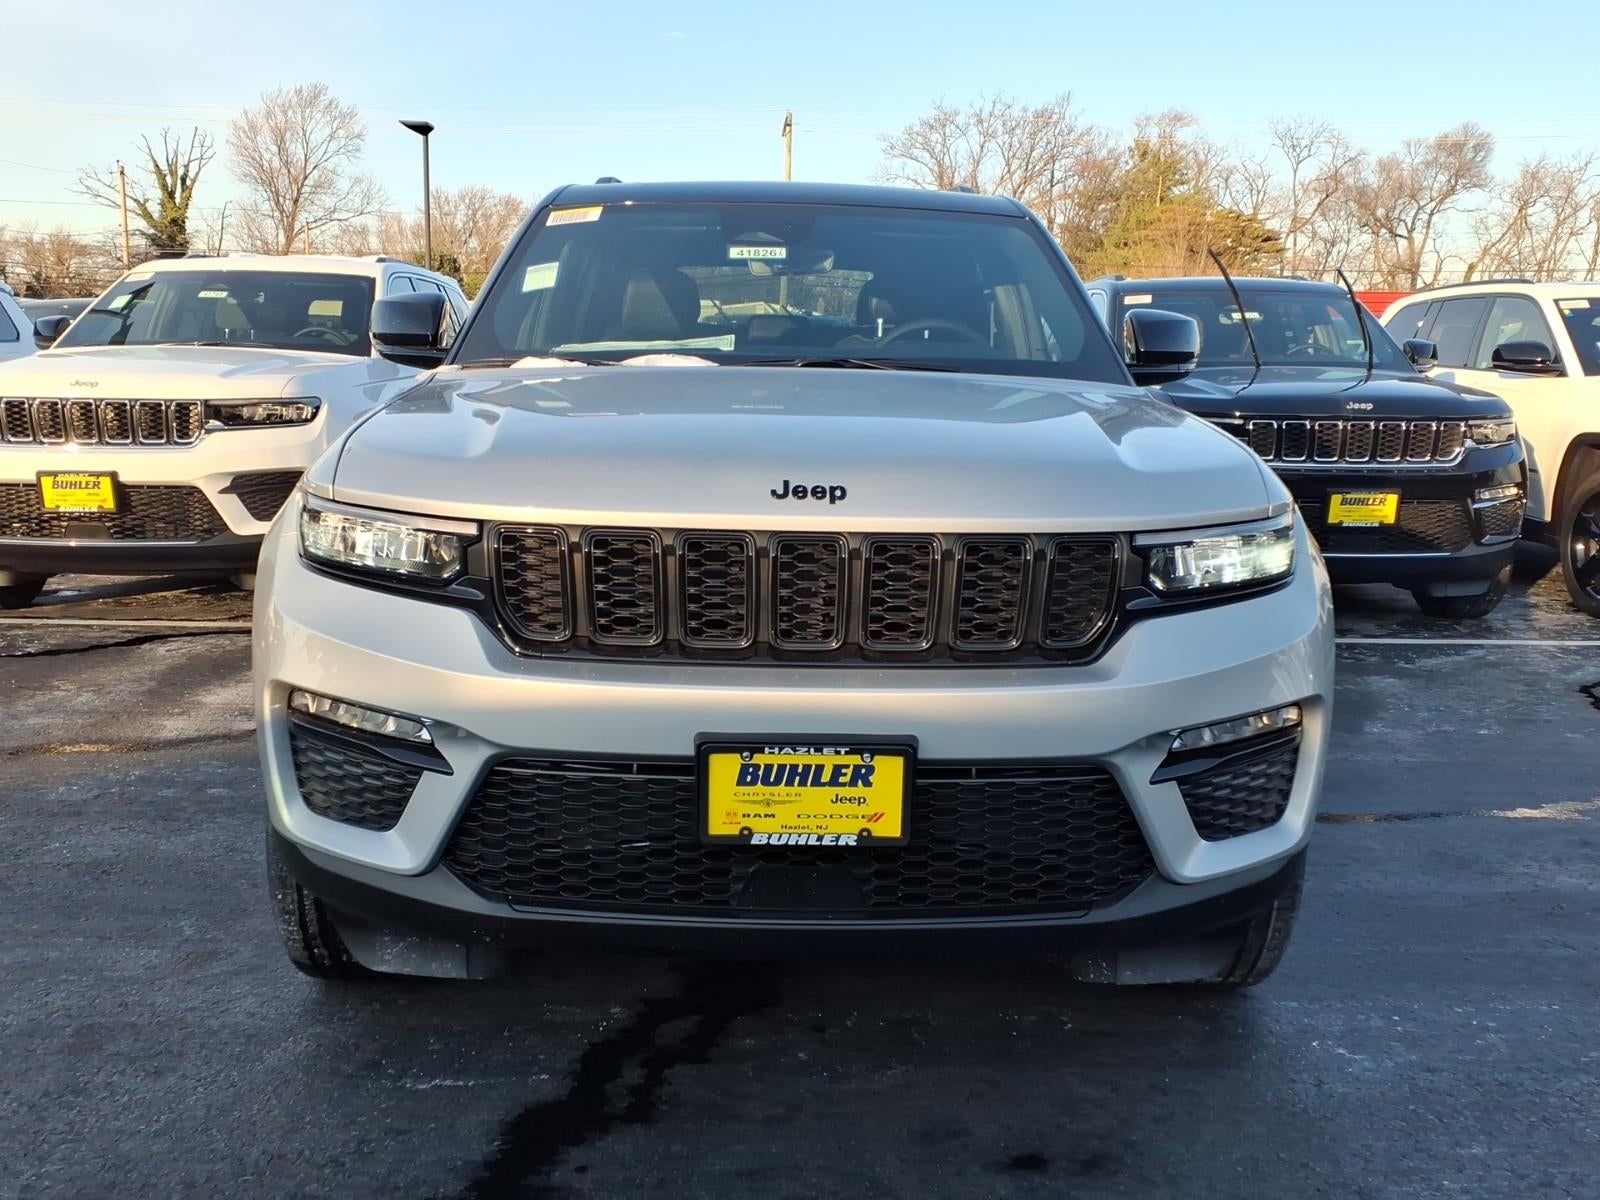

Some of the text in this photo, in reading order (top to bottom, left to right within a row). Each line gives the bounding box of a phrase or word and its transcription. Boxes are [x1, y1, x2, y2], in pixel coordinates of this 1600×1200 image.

[1346, 401, 1374, 411] Jeep
[51, 480, 102, 490] BUHLER
[770, 479, 847, 504] Jeep
[1340, 497, 1387, 506] BUHLER
[764, 747, 850, 755] HAZLET
[736, 763, 876, 788] BUHLER
[830, 793, 867, 806] Jeep
[750, 833, 858, 846] BUHLER
